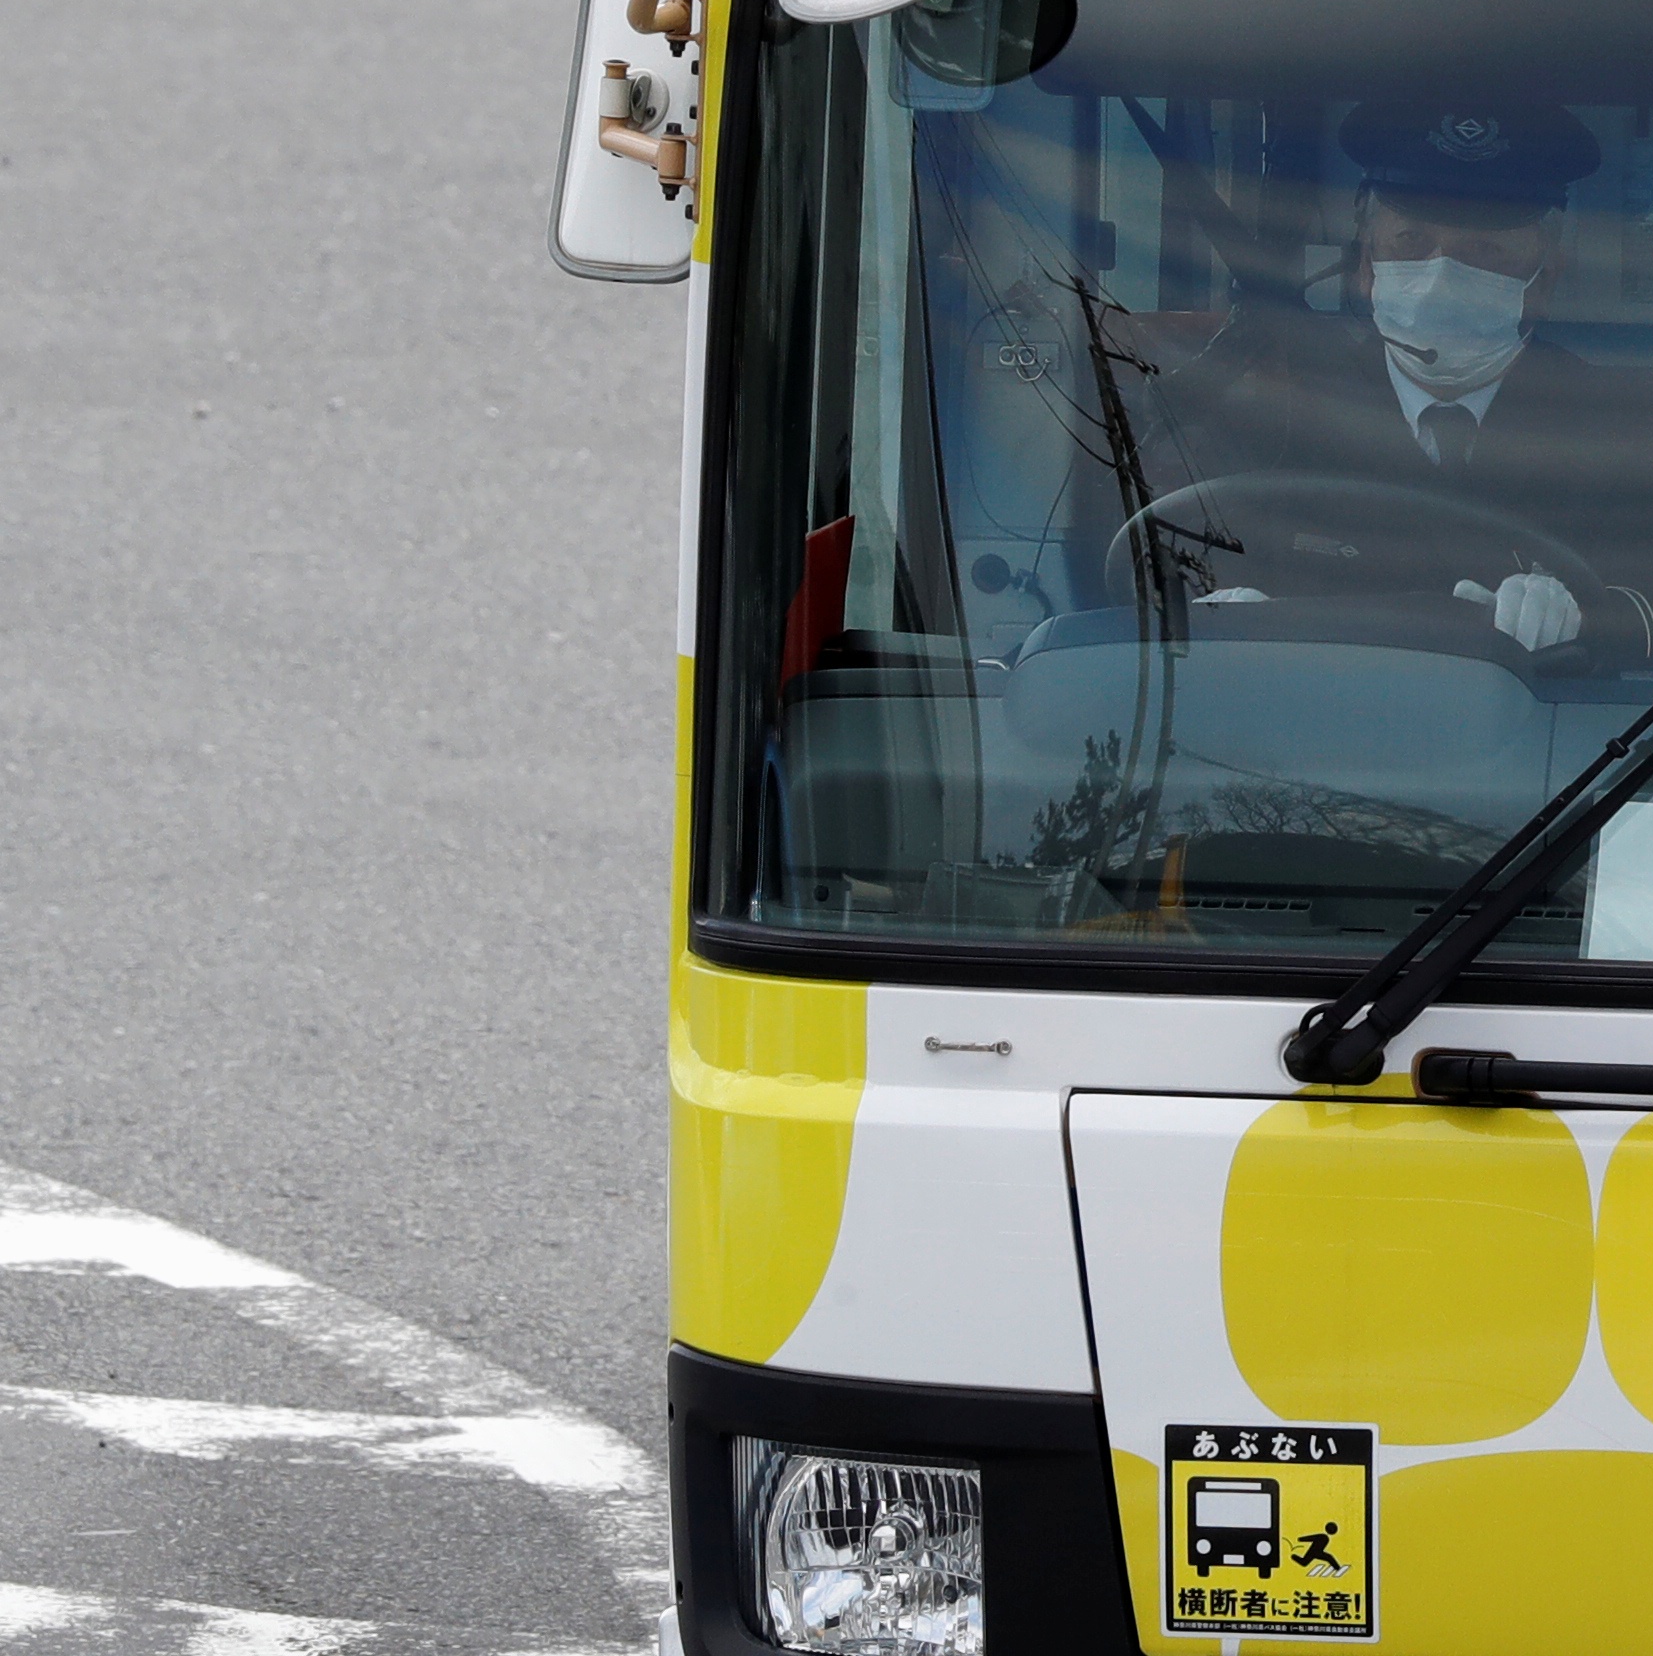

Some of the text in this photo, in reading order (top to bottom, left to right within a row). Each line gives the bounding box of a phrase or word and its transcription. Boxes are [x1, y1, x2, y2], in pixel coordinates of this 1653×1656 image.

[1192, 1430, 1338, 1460] あぶない
[1177, 1586, 1363, 1622] 横断者に注意!
